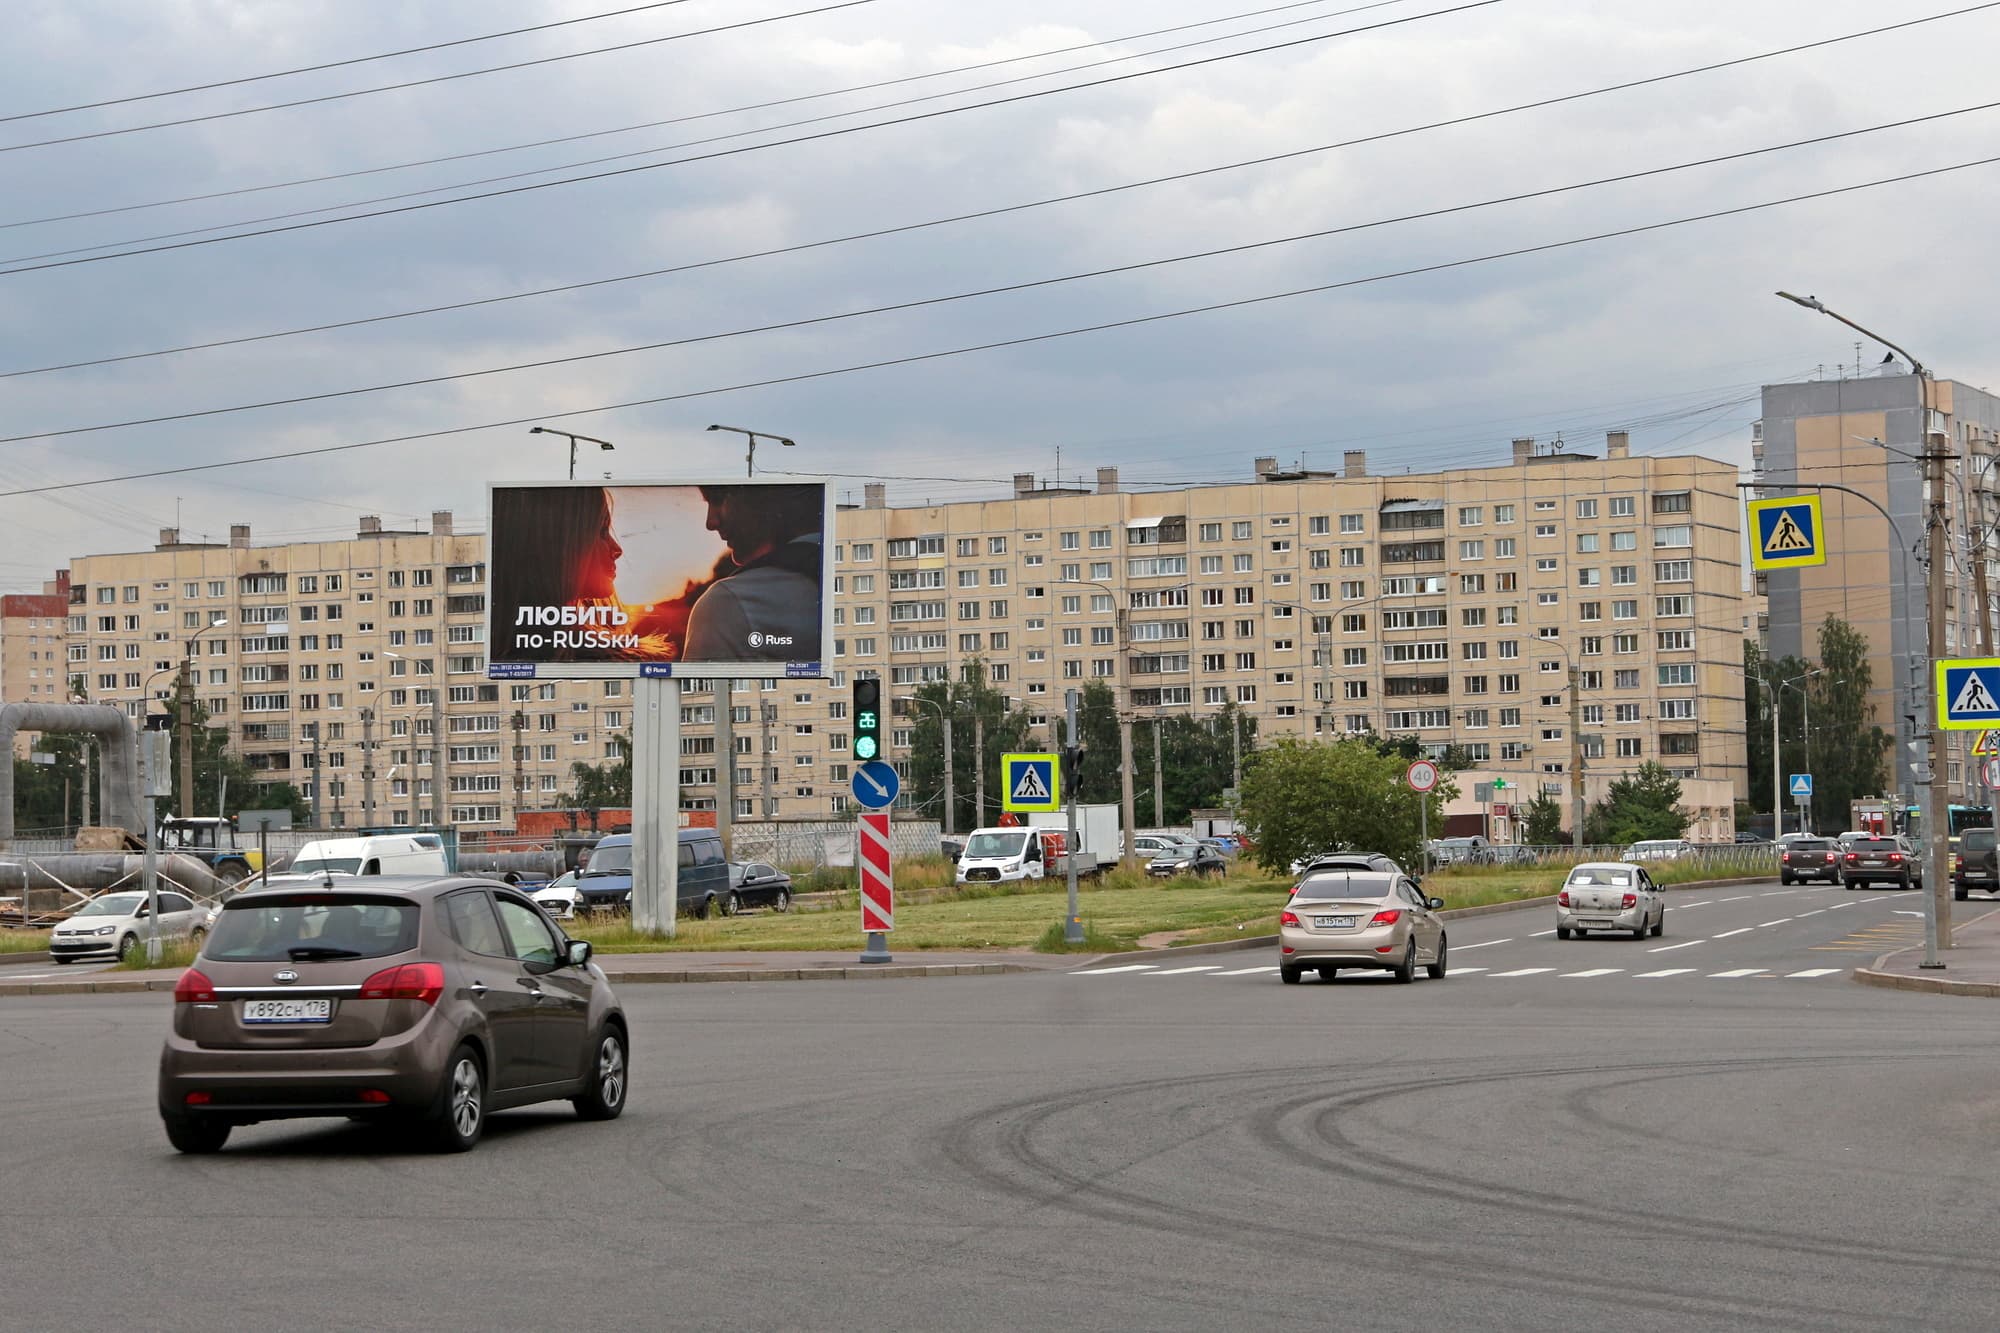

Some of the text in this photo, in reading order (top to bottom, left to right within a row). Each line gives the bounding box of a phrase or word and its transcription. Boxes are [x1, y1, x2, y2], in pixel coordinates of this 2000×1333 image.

[515, 606, 629, 626] ЛЮБИТЬ
[516, 630, 639, 649] по-RUSSки
[765, 634, 793, 645] Russ
[859, 712, 876, 729] 26
[1413, 770, 1432, 782] 40
